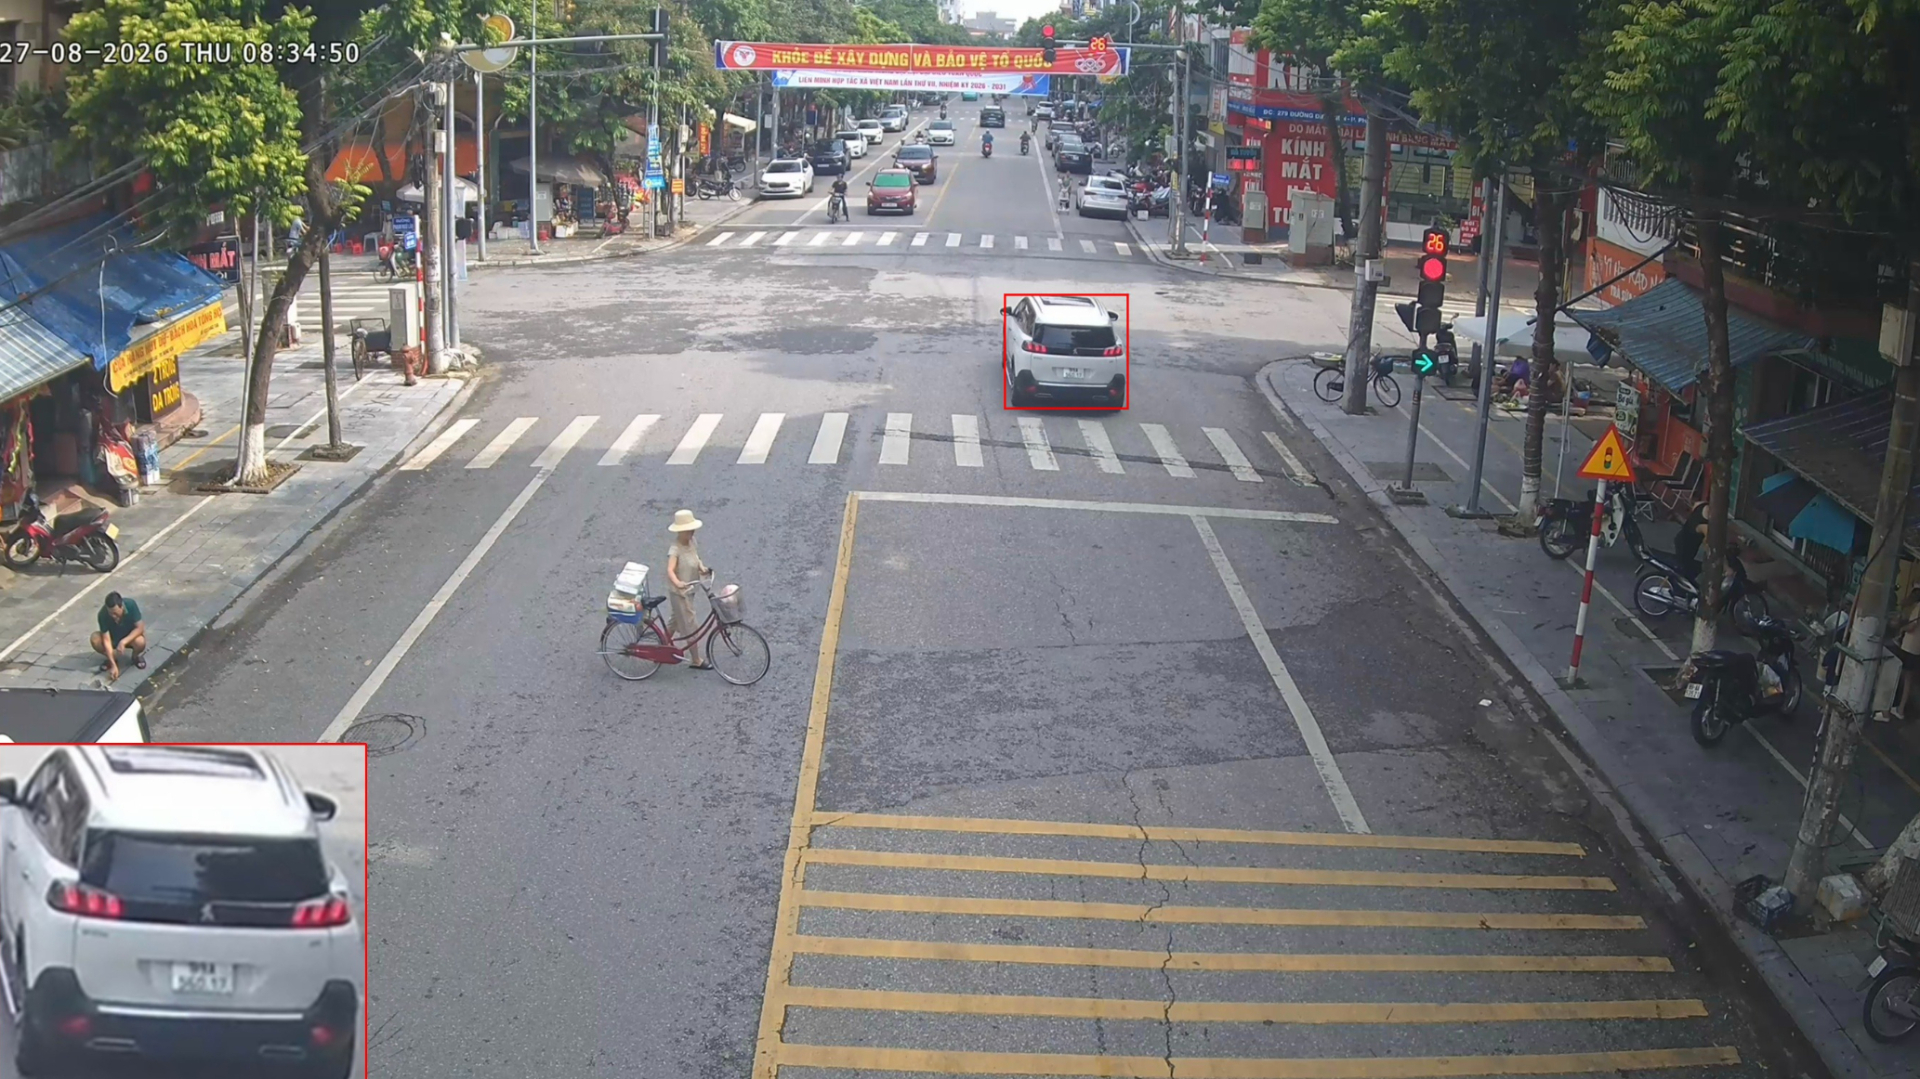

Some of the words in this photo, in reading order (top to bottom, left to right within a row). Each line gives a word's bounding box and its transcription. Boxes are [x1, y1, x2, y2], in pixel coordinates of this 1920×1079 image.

[1090, 37, 1104, 50] 26
[772, 47, 809, 64] KHỎE
[814, 46, 833, 65] ĐỂ
[837, 49, 865, 65] XÂY
[869, 51, 909, 69] DỰNG
[913, 50, 932, 67] VÀ
[937, 49, 965, 67] BẢO
[970, 51, 987, 70] VỆ
[992, 50, 1010, 67] TỔ
[869, 78, 882, 87] VIỆT
[970, 82, 986, 90] 2026
[1281, 136, 1325, 157] KÍNH
[1281, 156, 1323, 180] MẮT
[1426, 233, 1444, 252] 26
